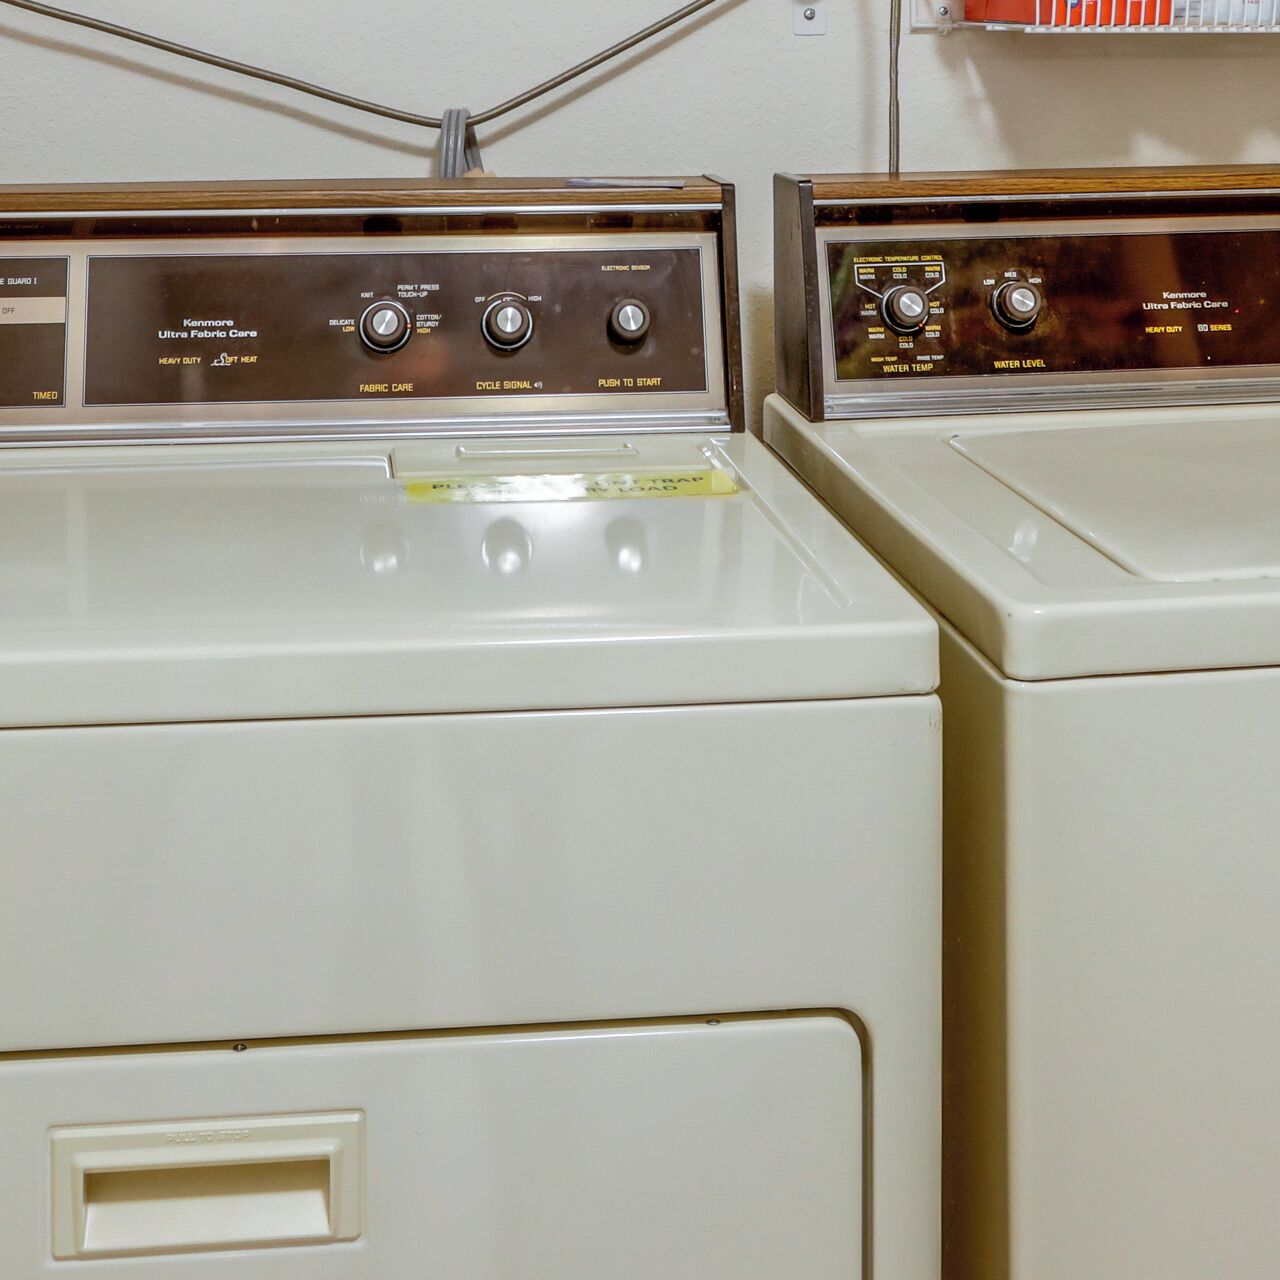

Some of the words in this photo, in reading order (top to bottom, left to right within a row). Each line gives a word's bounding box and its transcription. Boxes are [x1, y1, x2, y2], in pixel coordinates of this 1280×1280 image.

[7, 277, 32, 285] GUARD
[1162, 291, 1207, 299] Kenmore
[1170, 301, 1202, 309] Fabric
[183, 318, 235, 327] Kenmore
[1166, 325, 1183, 333] DUTY
[1210, 323, 1232, 331] SERIES
[158, 330, 188, 339] Ultra
[190, 329, 227, 338] Fabric
[228, 329, 258, 337] Care
[182, 356, 202, 364] DUTY
[240, 355, 258, 363] HEAT
[993, 360, 1020, 369] WATER
[1022, 359, 1046, 368] LEVEL
[883, 364, 910, 373] WATER
[911, 363, 934, 372] TEMP
[476, 381, 501, 390] CYCLE
[503, 381, 532, 389] SIGNAL
[598, 379, 620, 387] PUSH
[622, 378, 634, 387] TO
[636, 378, 662, 386] START
[359, 384, 389, 392] FABRIC
[391, 383, 414, 392] CARE
[32, 391, 58, 399] TIMED
[643, 476, 704, 484] TRAP
[619, 485, 678, 493] LOAD
[198, 1131, 214, 1142] TO
